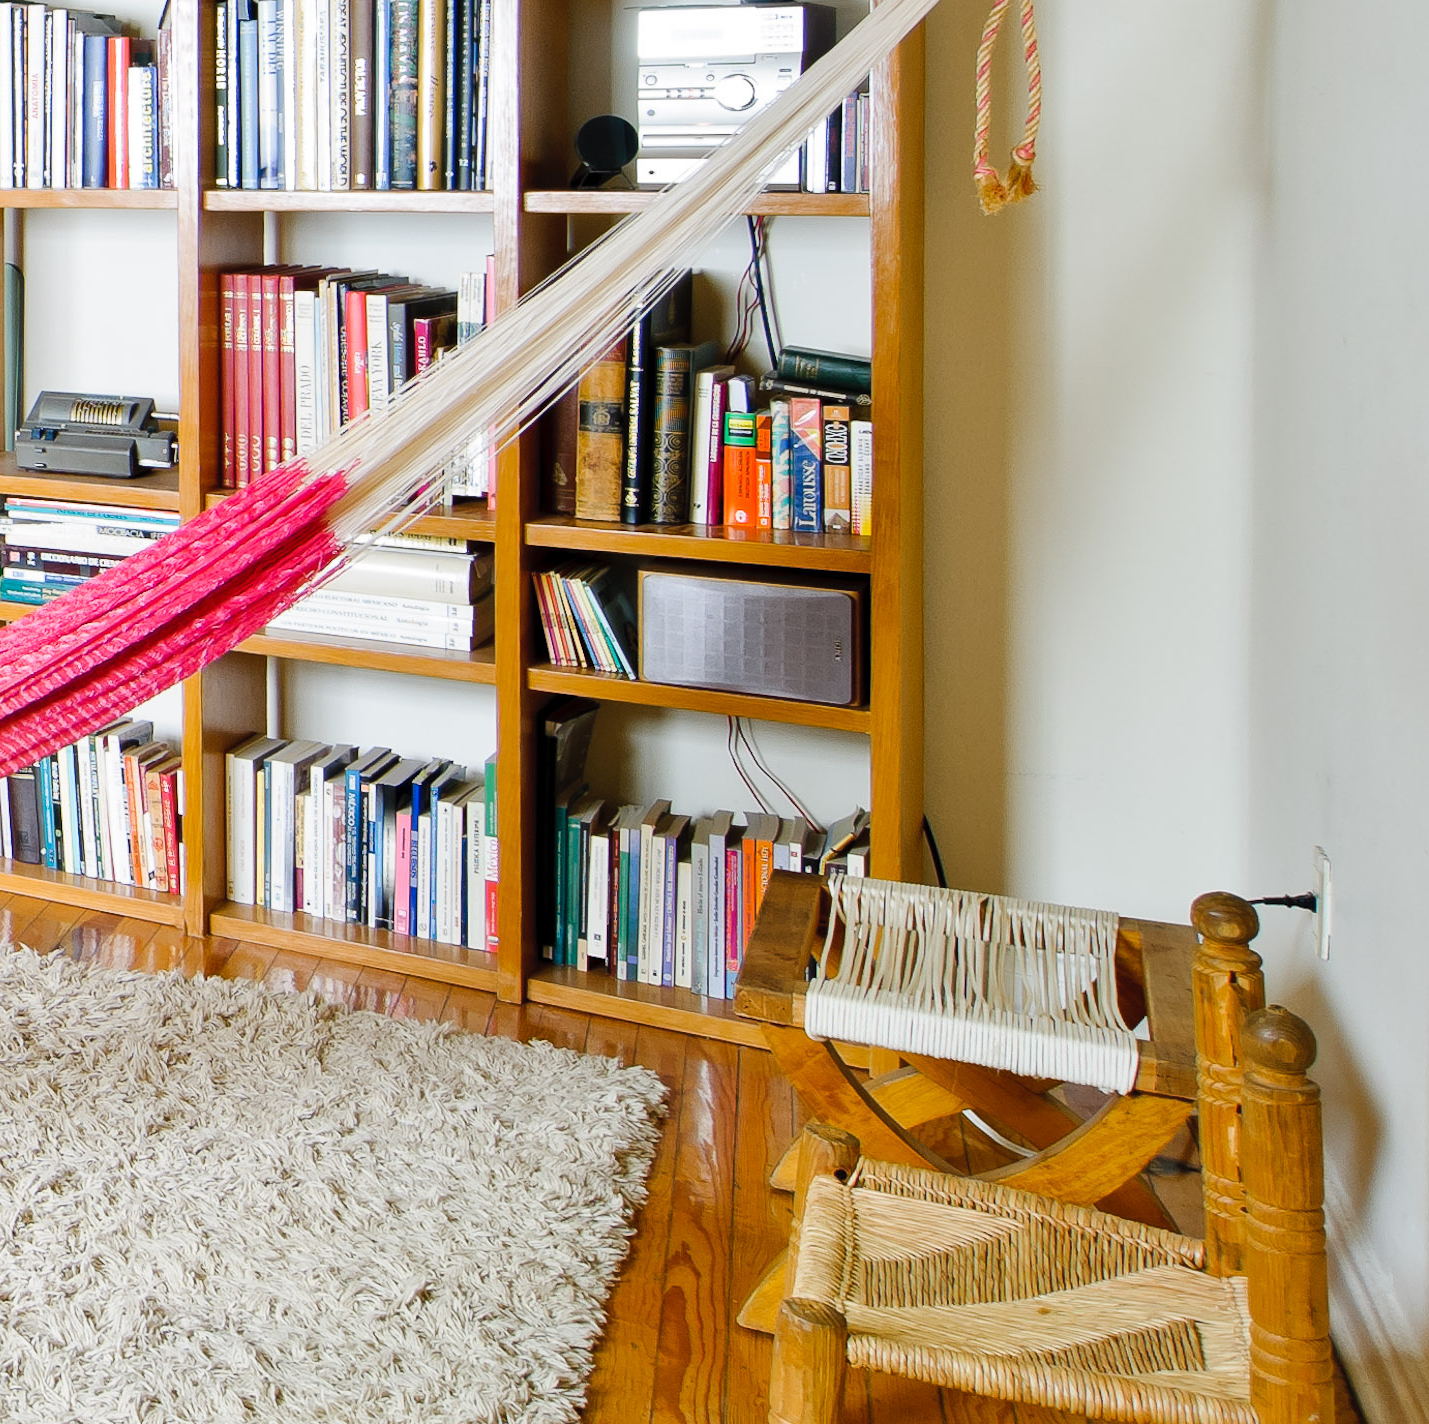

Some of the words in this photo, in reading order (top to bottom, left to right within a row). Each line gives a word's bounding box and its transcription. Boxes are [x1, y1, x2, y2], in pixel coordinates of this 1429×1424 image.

[275, 8, 285, 72] WINNIPEG
[393, 28, 411, 84] MAYAS
[338, 31, 347, 107] ARCHITECTURE
[31, 72, 40, 120] ANATOMIA
[140, 70, 153, 174] architecture
[339, 107, 348, 125] OF
[339, 124, 348, 143] THE
[338, 144, 348, 187] WORLD
[371, 340, 383, 375] YORK
[392, 364, 403, 379] and
[299, 364, 312, 408] PRADO
[628, 379, 640, 416] SALVAT
[300, 412, 313, 439] DEL
[823, 423, 847, 465] OXFORD
[797, 459, 817, 528] Larousse
[322, 608, 389, 622] CONSTITUCIONAL
[324, 594, 361, 605] ELECTORAL
[362, 598, 398, 608] MEXICANO
[293, 621, 324, 631] PARTIDOS
[347, 792, 359, 827] MÉXICO
[485, 838, 500, 879] México
